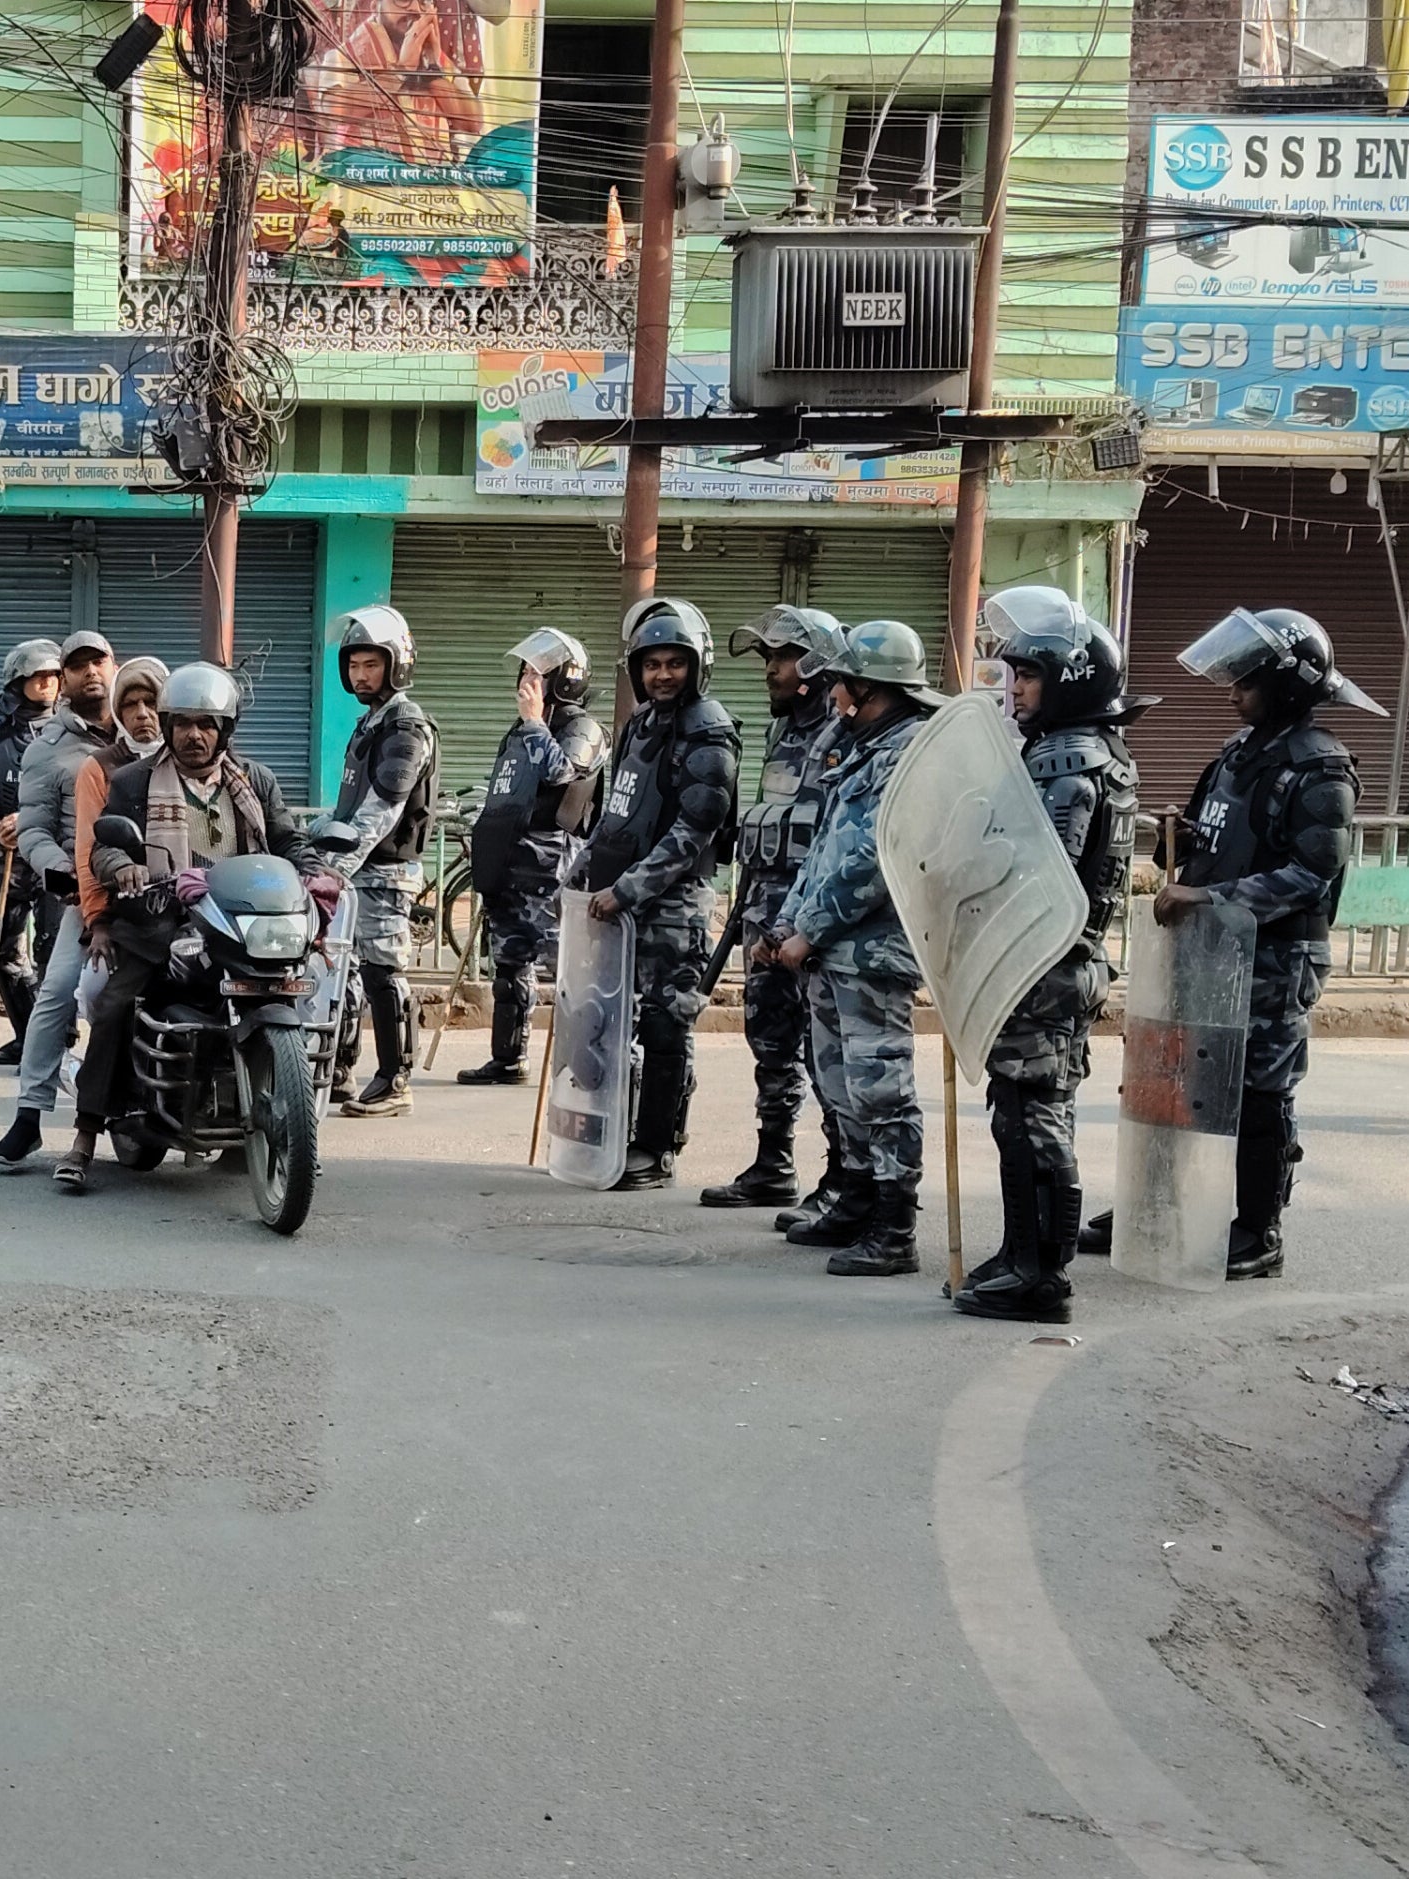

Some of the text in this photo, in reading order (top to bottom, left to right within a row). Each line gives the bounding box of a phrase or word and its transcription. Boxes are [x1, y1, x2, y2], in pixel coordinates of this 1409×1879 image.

[1164, 142, 1232, 173] SSB
[400, 190, 460, 205] आयोजक
[1285, 193, 1329, 215] Laptop,
[1333, 193, 1386, 212] Printers,
[1228, 281, 1253, 291] intel
[1261, 279, 1321, 295] lenovo
[1325, 279, 1378, 294] ASUS
[845, 299, 903, 321] NEEK
[1142, 322, 1249, 369] SSB
[482, 370, 568, 411] colors
[15, 419, 65, 435] वीरगंज
[1060, 665, 1096, 683] APF
[1199, 800, 1230, 829] A.P.F.
